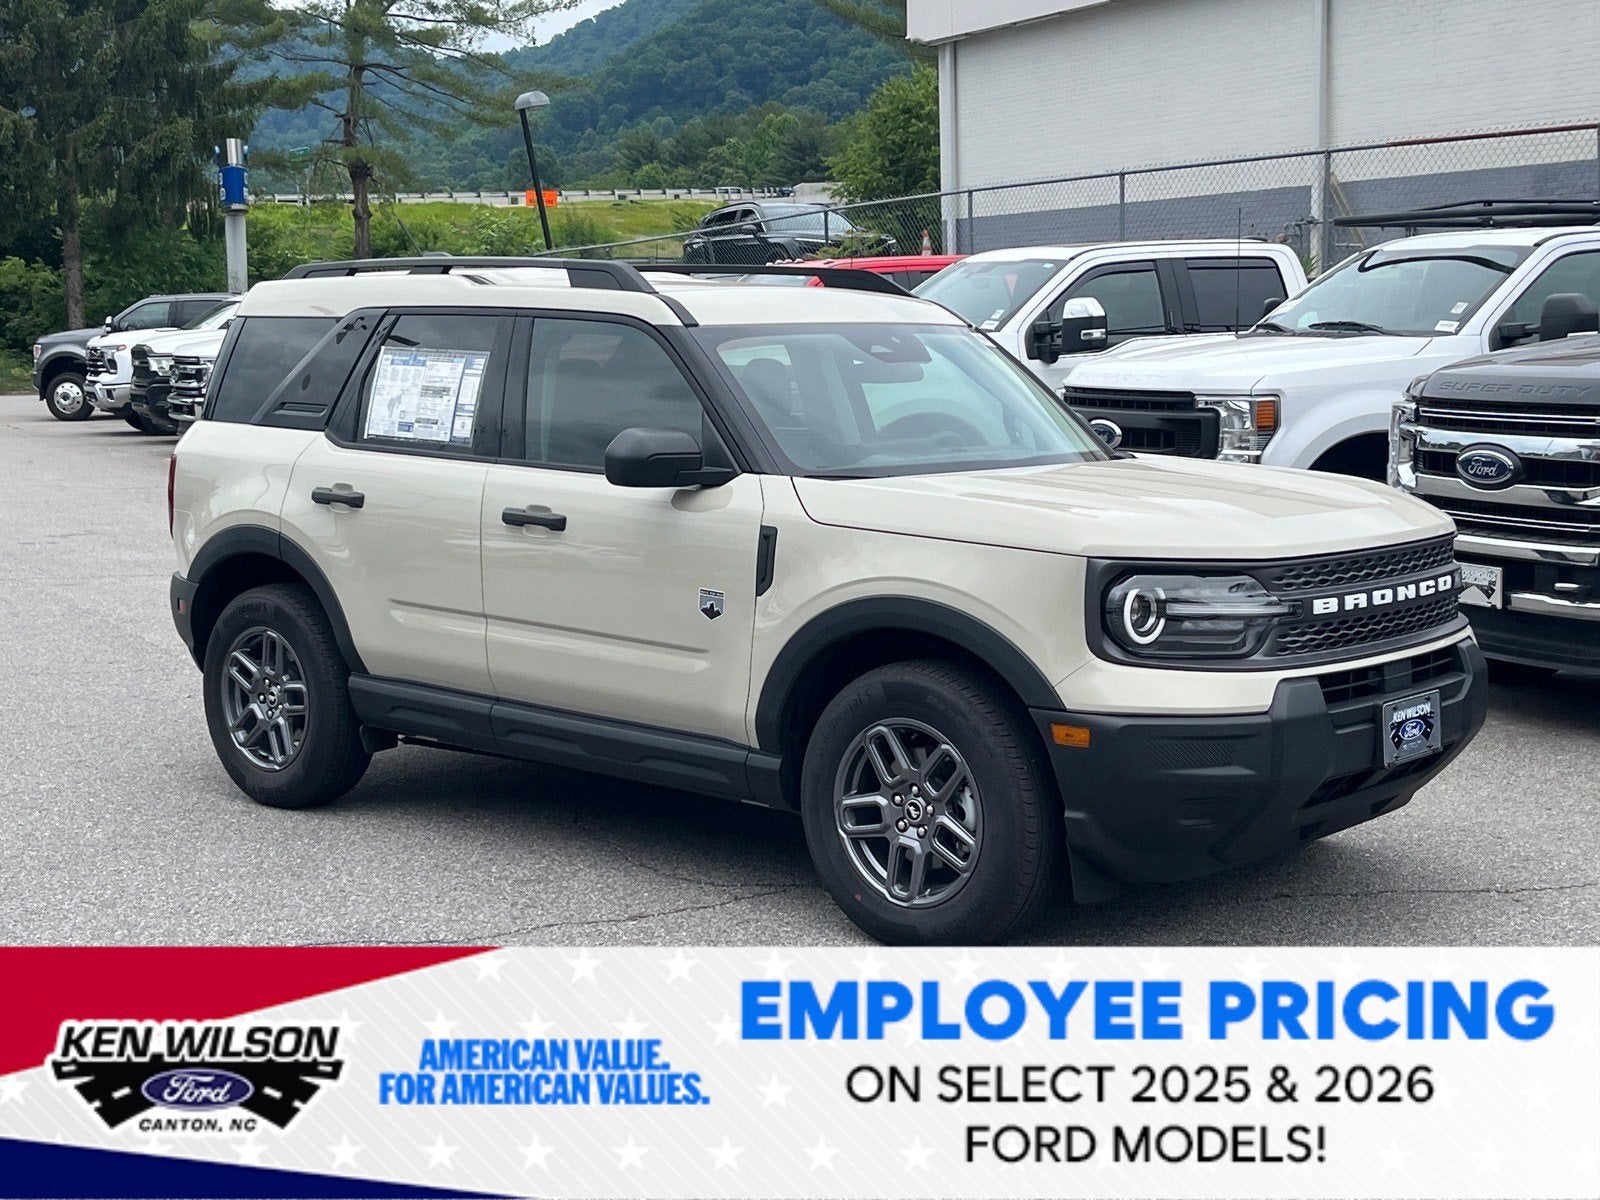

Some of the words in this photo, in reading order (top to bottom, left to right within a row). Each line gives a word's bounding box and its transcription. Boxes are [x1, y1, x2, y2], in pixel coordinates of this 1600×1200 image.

[1439, 381, 1512, 393] SUPER
[1516, 384, 1593, 397] DUTY
[1467, 456, 1499, 477] Ford
[1312, 574, 1452, 615] BRONCO
[1389, 710, 1406, 724] KEN
[1404, 702, 1431, 719] WILSON
[1404, 722, 1420, 738] Ford
